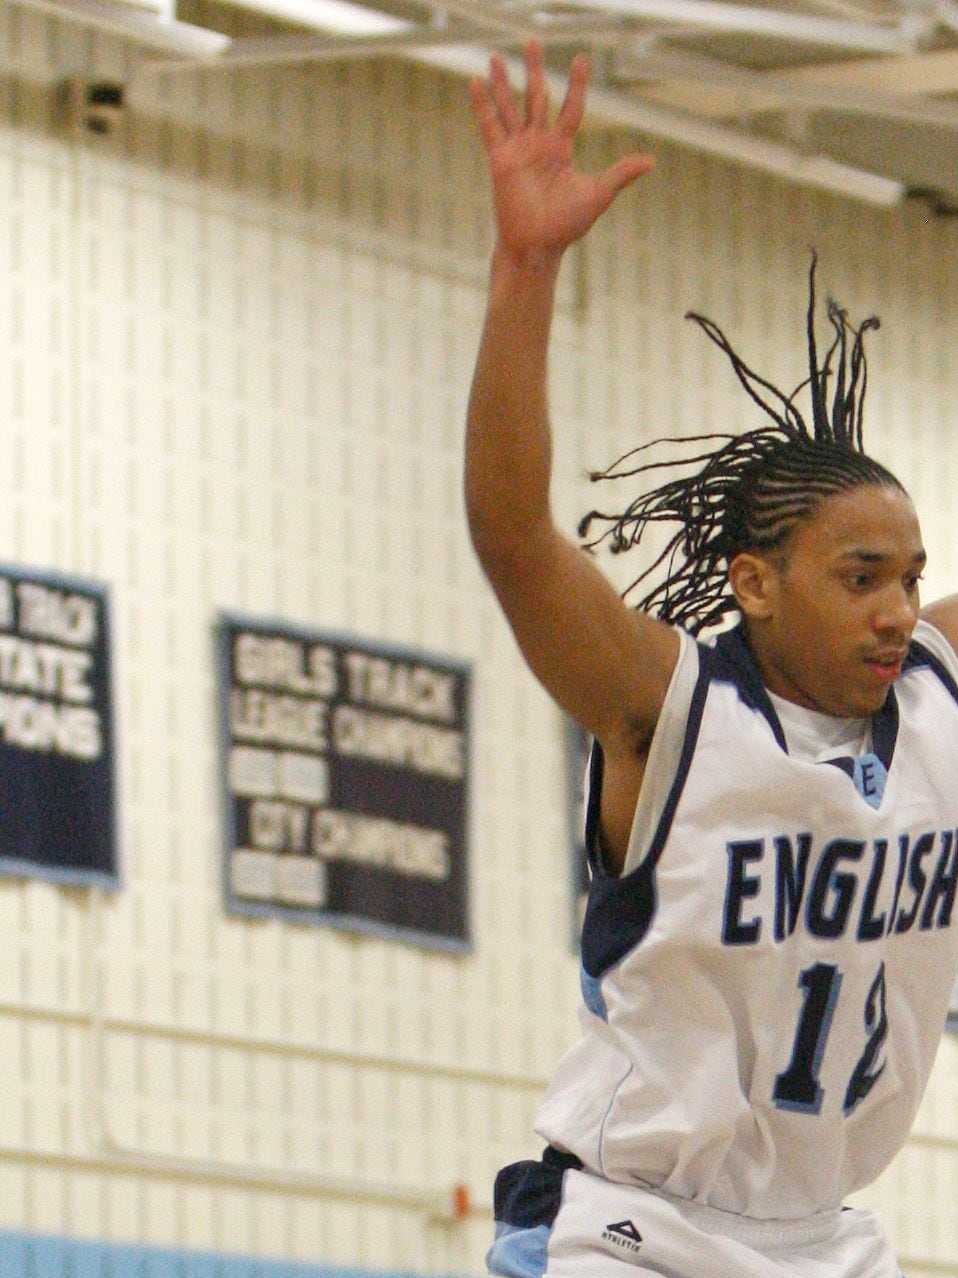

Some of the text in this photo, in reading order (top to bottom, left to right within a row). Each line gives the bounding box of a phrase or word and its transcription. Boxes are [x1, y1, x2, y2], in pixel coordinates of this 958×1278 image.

[234, 632, 457, 724] GIRLS TRACK
[861, 761, 877, 797] E
[772, 959, 888, 1120] 12
